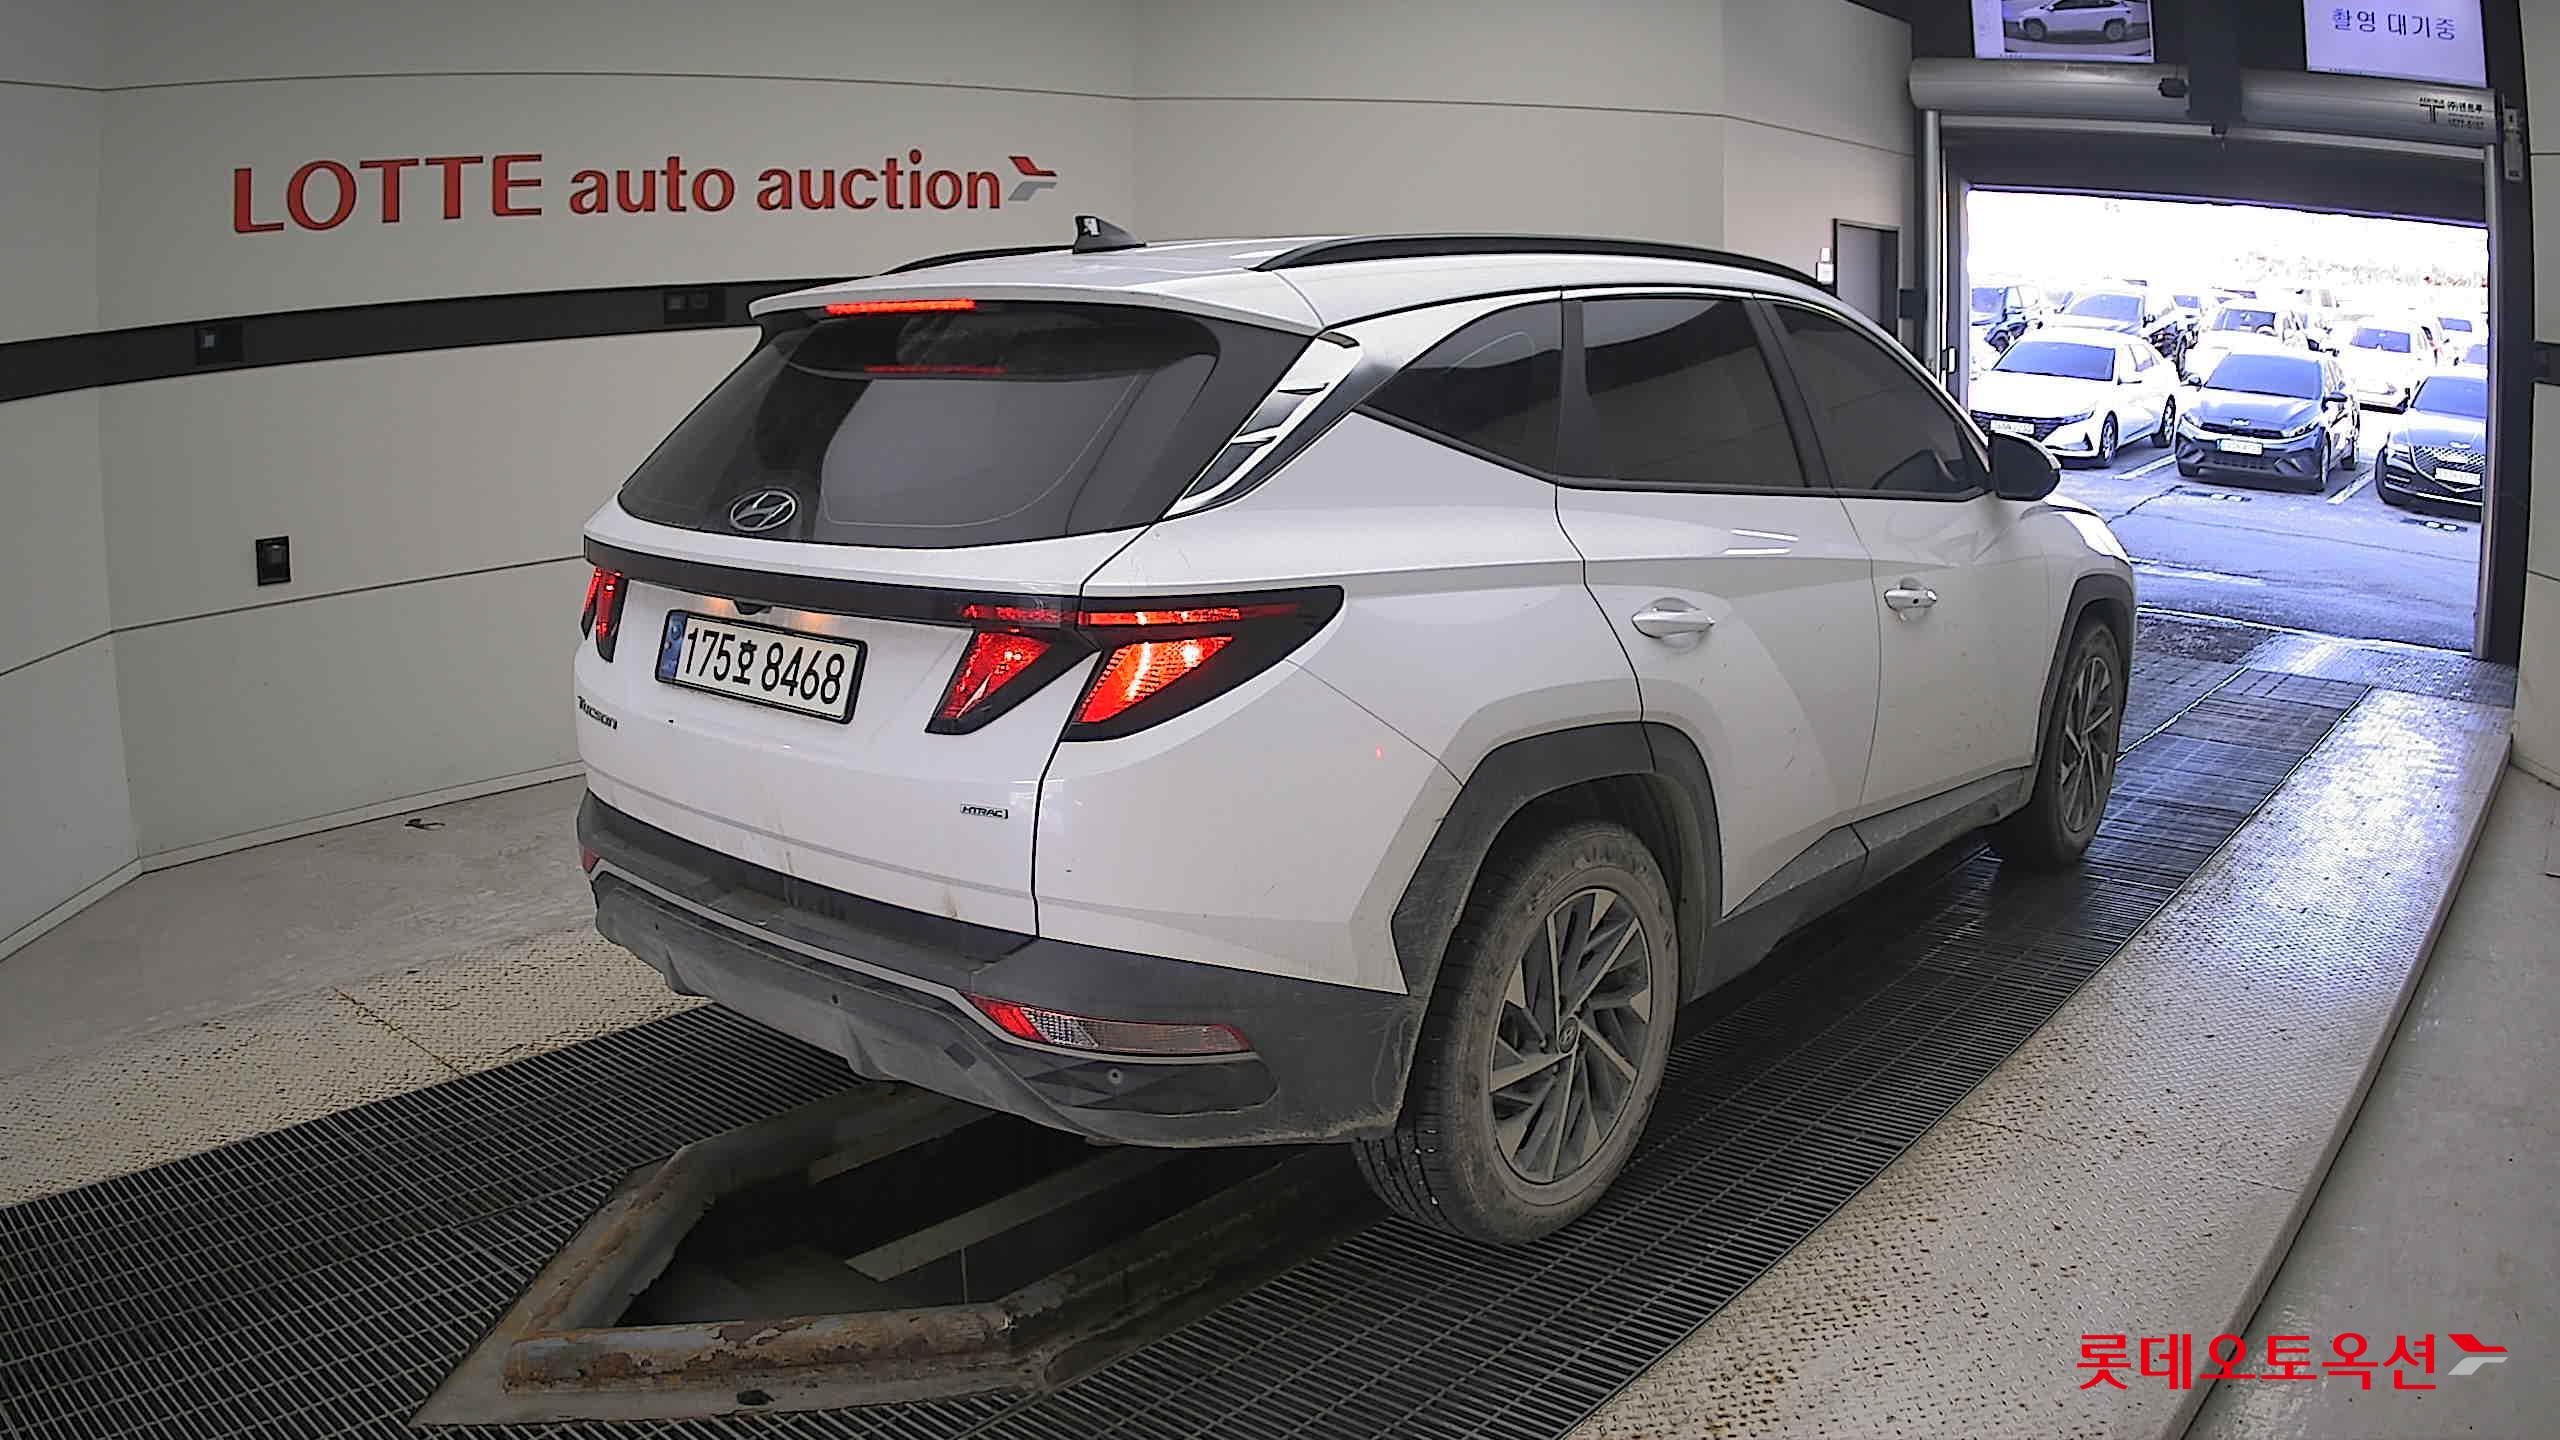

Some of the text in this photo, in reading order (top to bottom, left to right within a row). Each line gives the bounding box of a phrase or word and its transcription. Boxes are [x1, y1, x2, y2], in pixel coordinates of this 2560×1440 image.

[2332, 9, 2456, 41] 촬영 대기중
[233, 149, 1002, 234] LOTTE auto auction
[685, 627, 846, 705] 175호 8468
